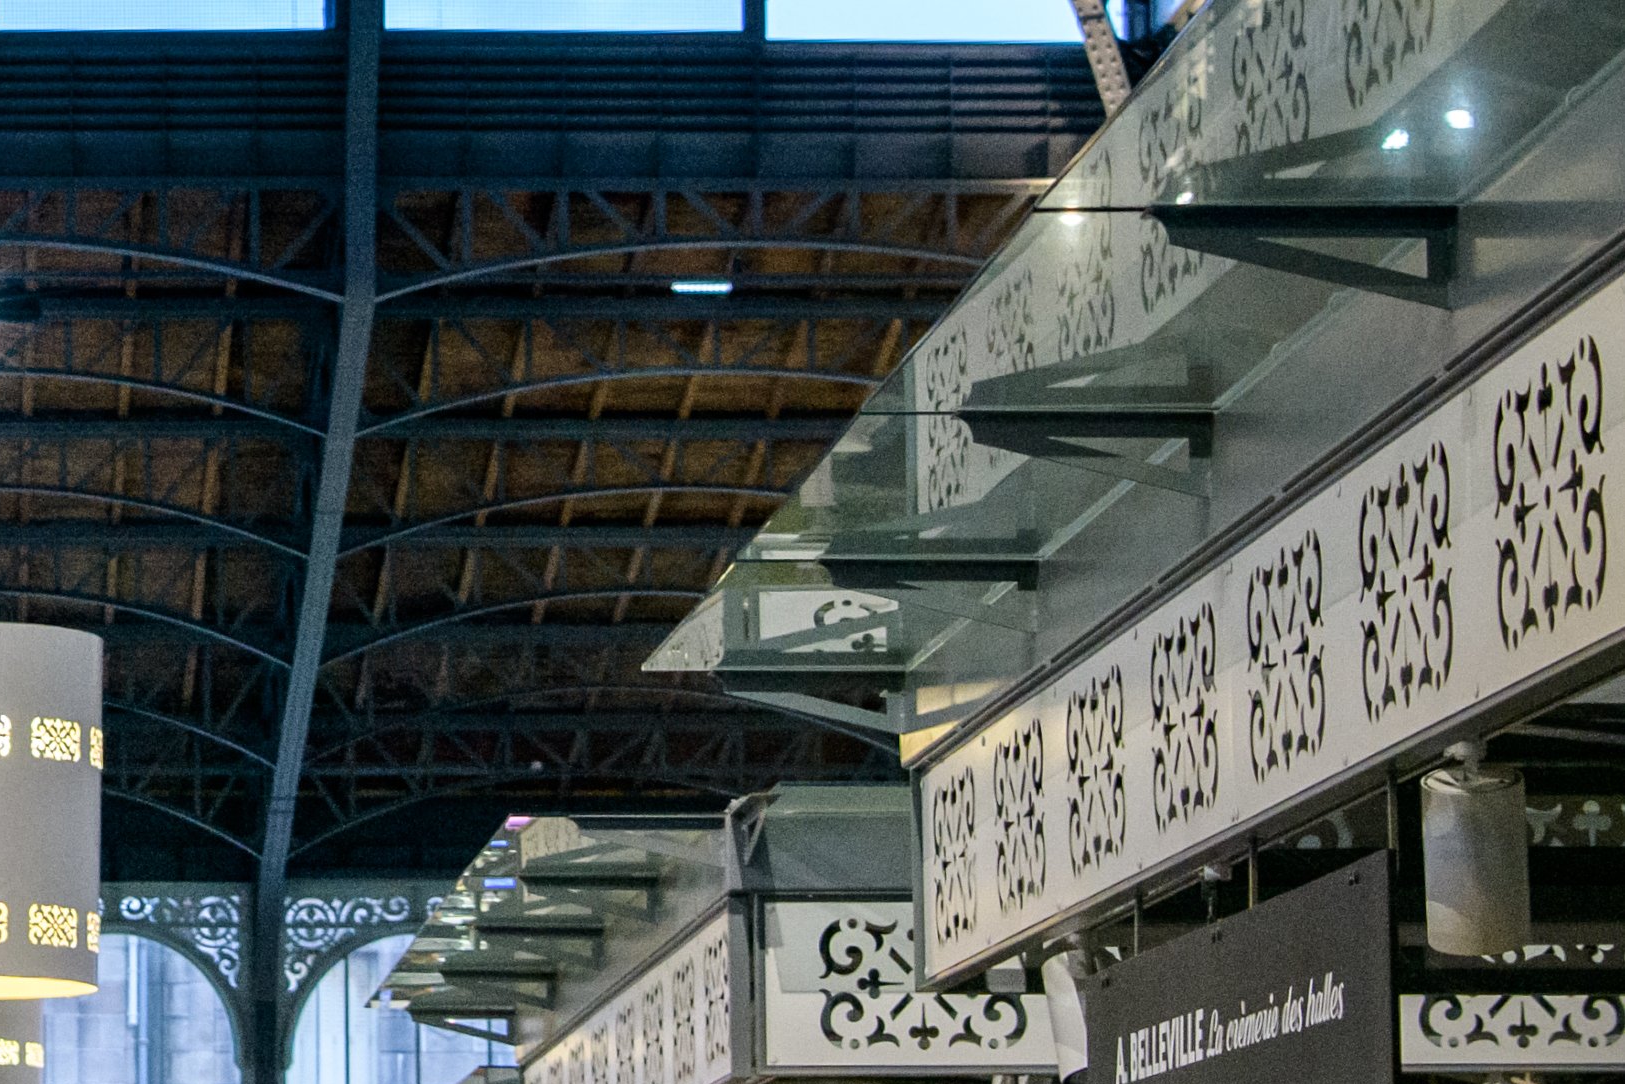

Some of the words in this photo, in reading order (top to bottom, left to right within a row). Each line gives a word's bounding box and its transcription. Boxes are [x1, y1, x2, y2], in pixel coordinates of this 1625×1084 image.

[1129, 1008, 1205, 1083] BELLEVILLE
[1206, 1008, 1224, 1058] La
[1226, 992, 1280, 1052] crèmerie
[1281, 985, 1305, 1035] des
[1305, 971, 1345, 1028] halles
